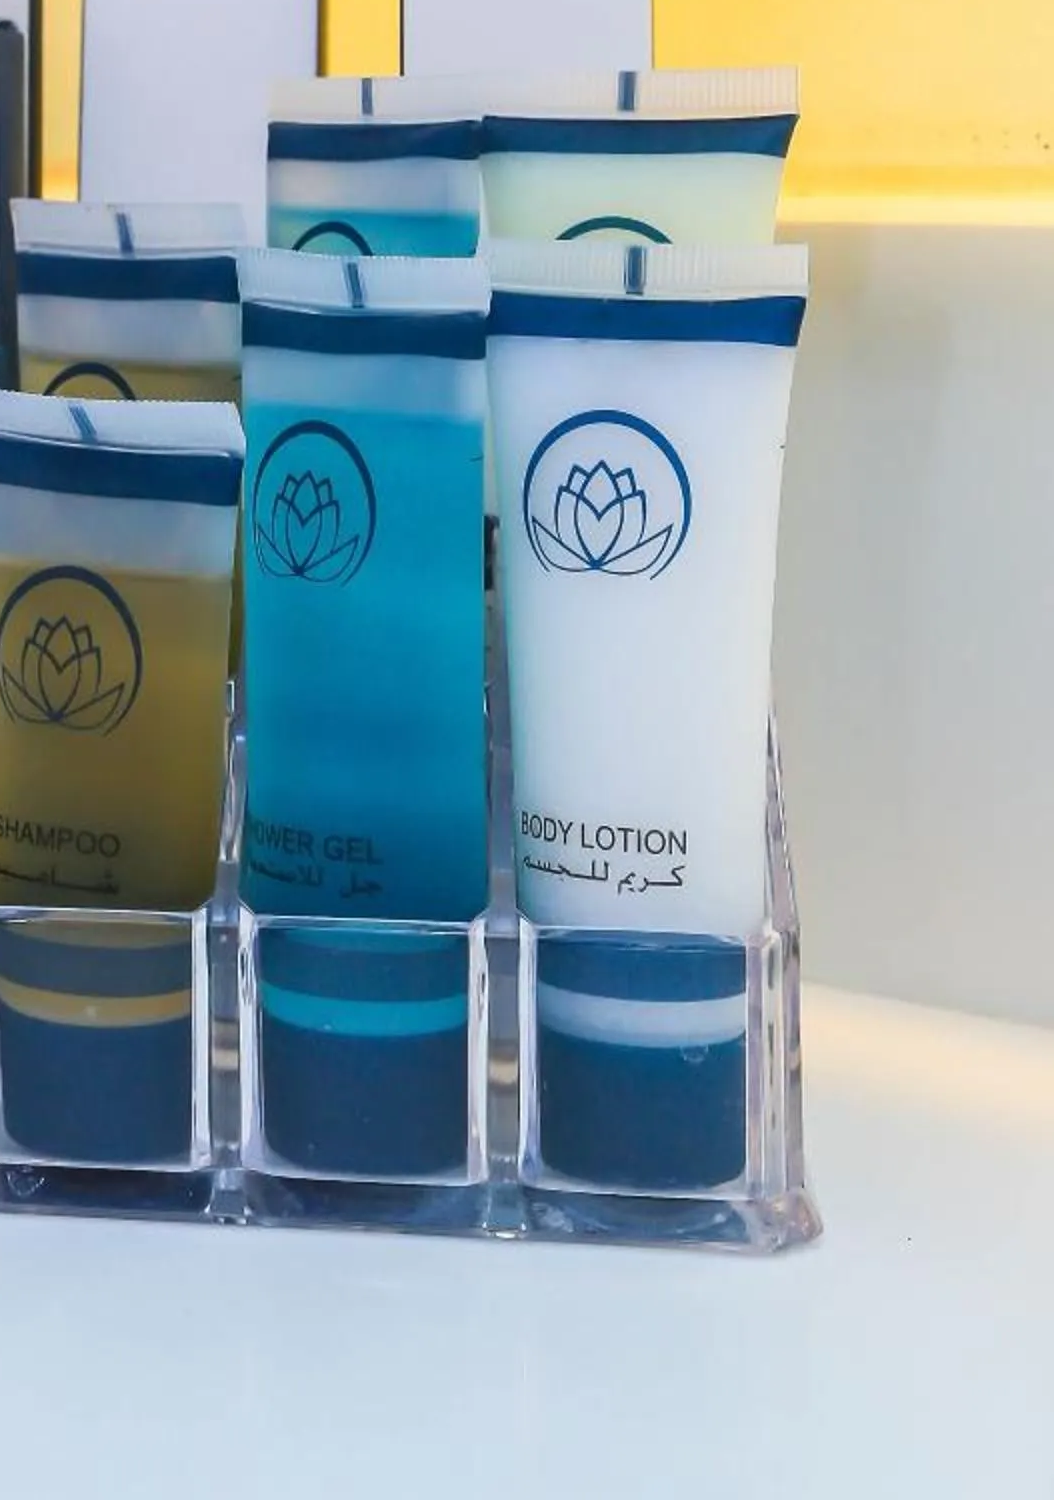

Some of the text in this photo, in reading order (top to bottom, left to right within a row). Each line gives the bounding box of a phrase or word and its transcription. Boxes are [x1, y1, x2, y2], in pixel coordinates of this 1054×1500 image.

[251, 820, 385, 865] OWER GEL
[521, 810, 687, 855] BODY LOTION
[617, 864, 686, 894] كريم
